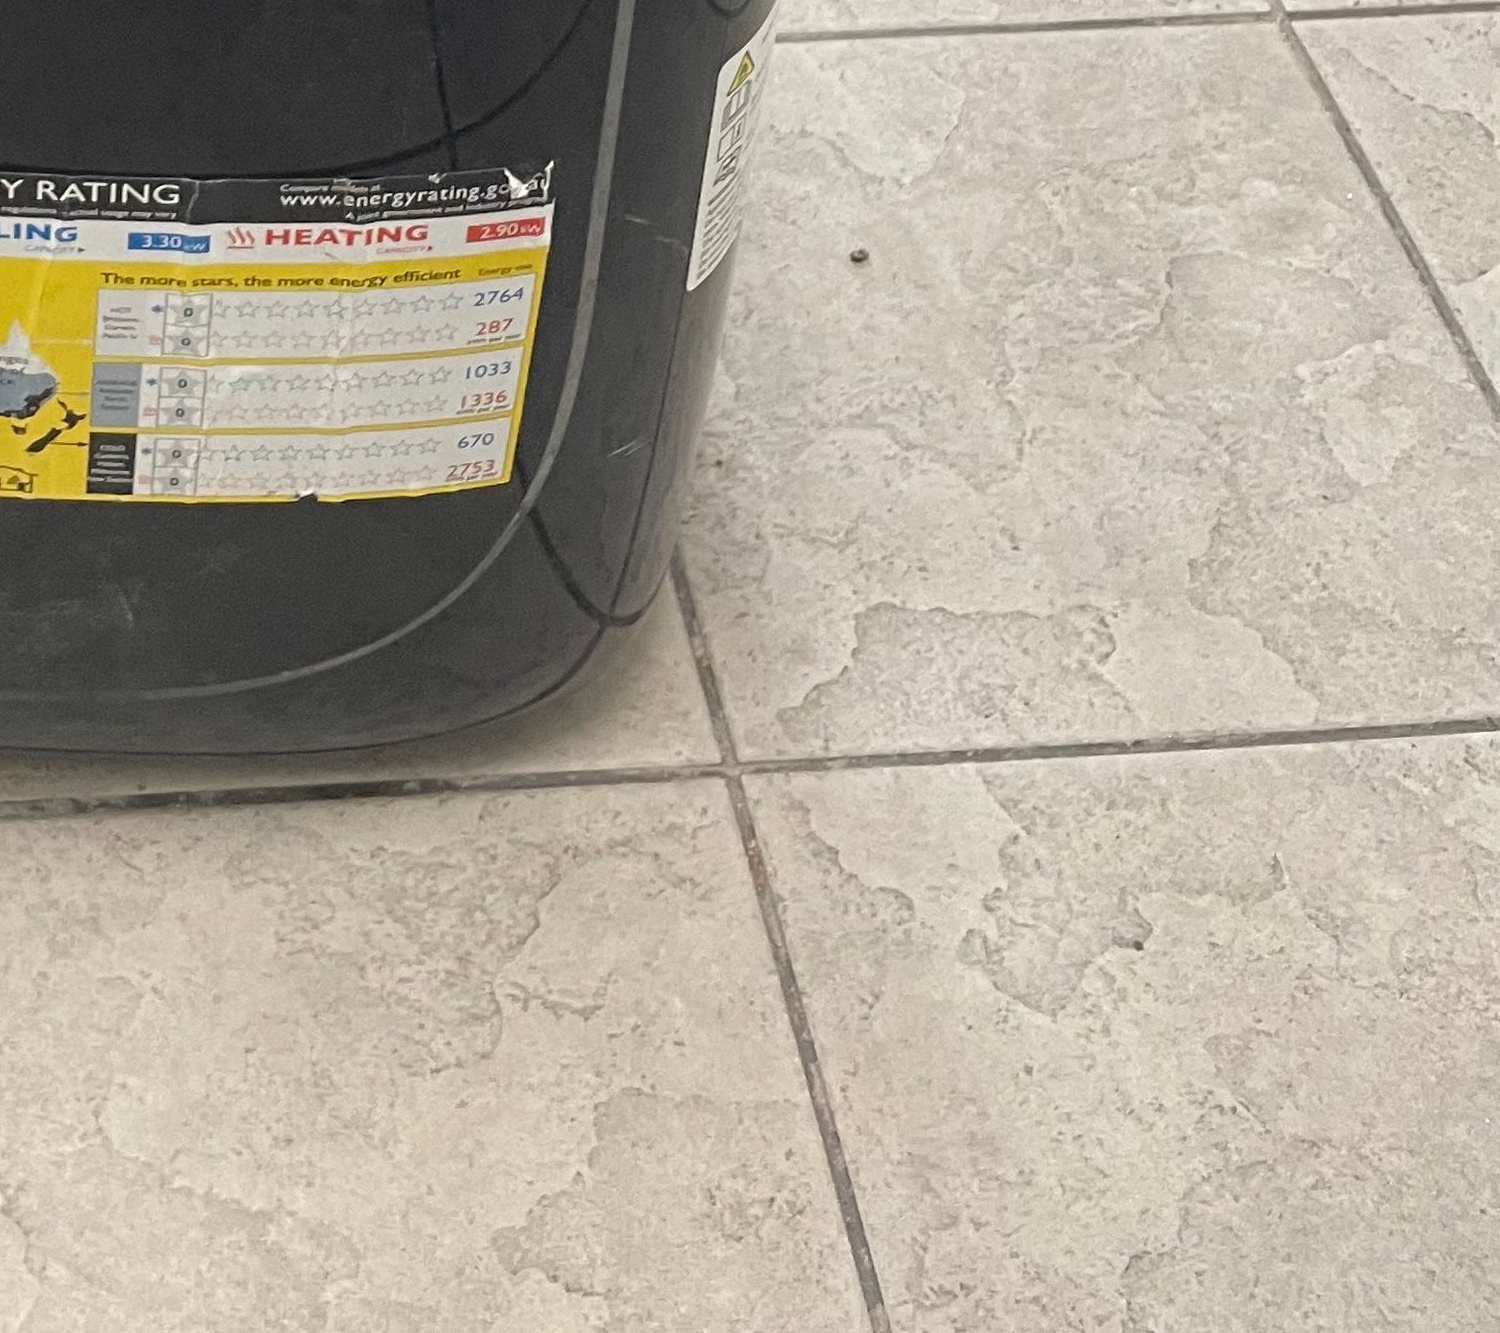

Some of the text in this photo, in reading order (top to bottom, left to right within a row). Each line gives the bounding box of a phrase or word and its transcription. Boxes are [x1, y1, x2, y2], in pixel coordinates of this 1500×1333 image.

[36, 179, 181, 205] RATING
[264, 224, 429, 246] HEATING
[100, 268, 462, 289] The more stars, the more energy efficient
[473, 286, 525, 308] 2764
[476, 317, 515, 336] 287
[465, 360, 513, 380] 1033
[460, 389, 507, 410] 1336
[457, 432, 495, 450] 670
[448, 459, 497, 479] 2753
